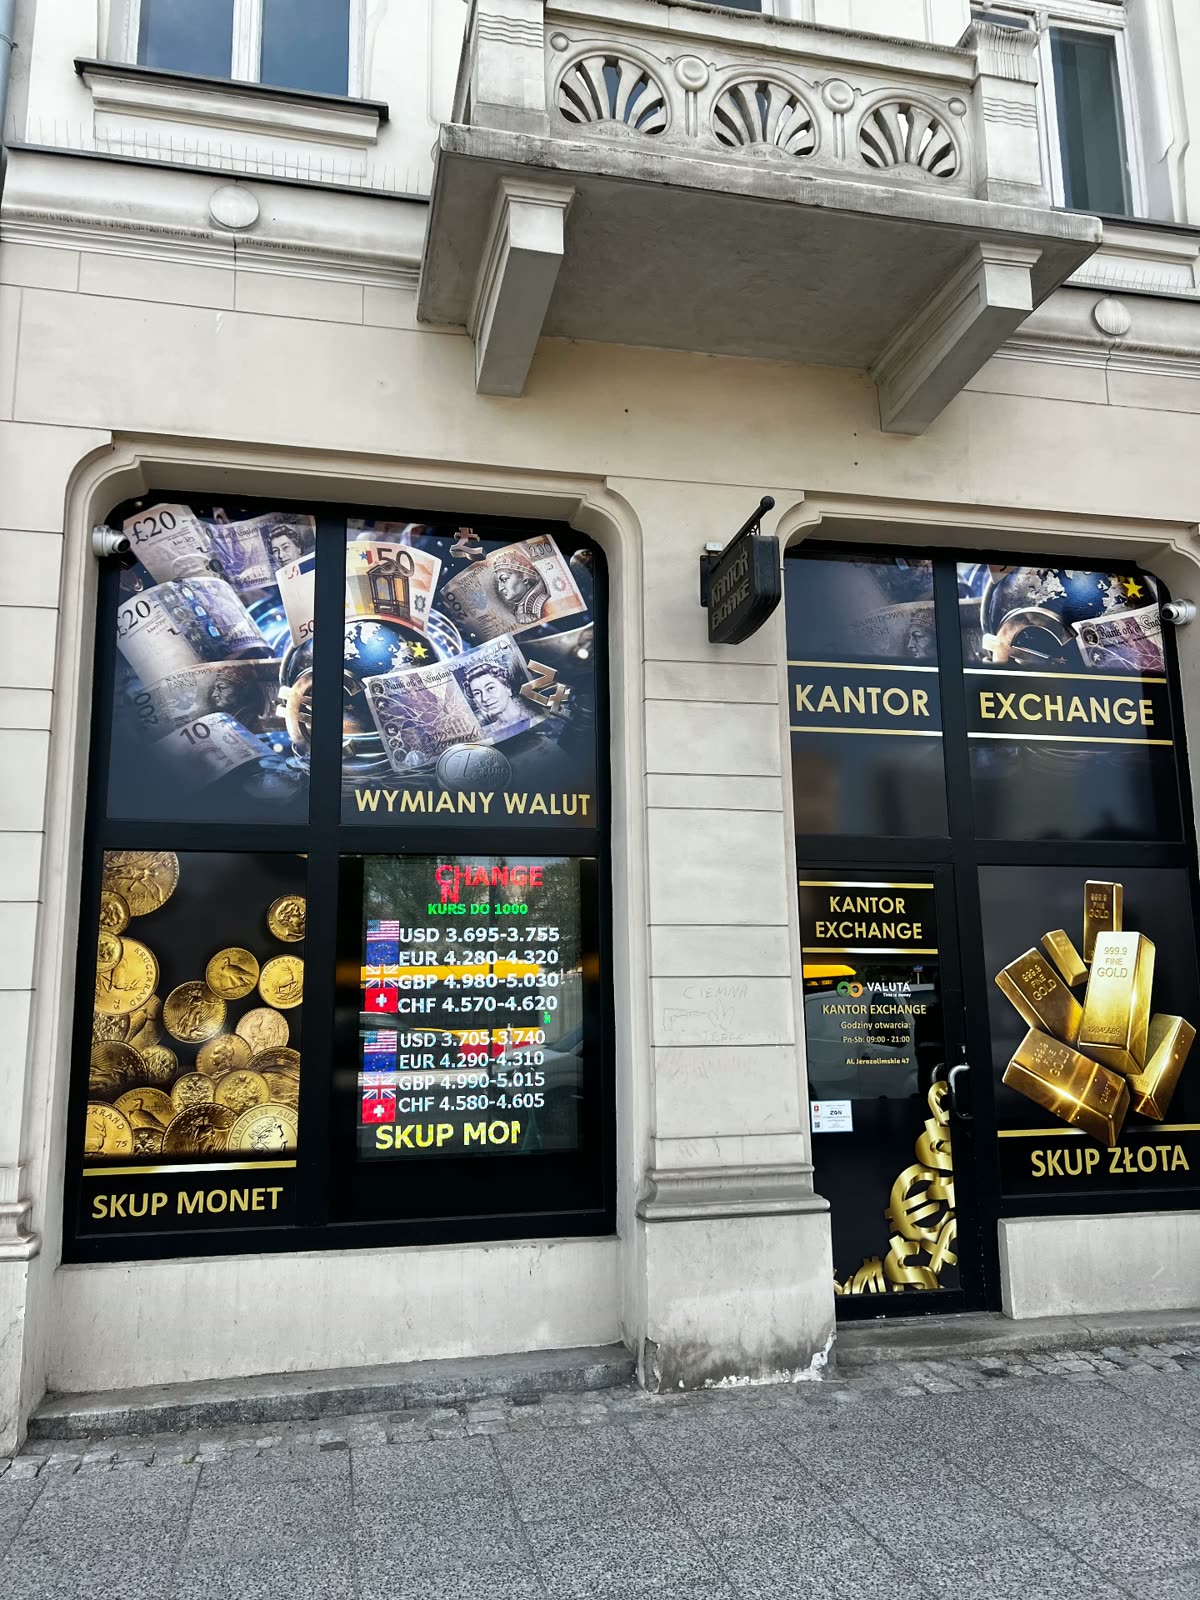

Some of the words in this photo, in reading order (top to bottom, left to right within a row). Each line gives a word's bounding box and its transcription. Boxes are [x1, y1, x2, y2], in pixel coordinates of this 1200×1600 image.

[377, 547, 415, 578] 50
[712, 551, 749, 607] KANTOR
[795, 684, 930, 717] KANTOR
[979, 691, 1154, 726] EXCHANGE
[180, 722, 211, 745] 10
[354, 789, 494, 814] WYMIANY
[504, 792, 591, 816] WALUT
[435, 864, 544, 886] CHANGE
[427, 903, 466, 915] KURS
[470, 903, 490, 915] DO
[494, 903, 529, 915] 1000
[829, 896, 906, 914] KANTOR
[400, 928, 440, 943] USD
[445, 927, 560, 943] 3.695-3.755
[815, 921, 923, 939] EXCHANGE
[399, 951, 439, 966] EUR
[443, 950, 559, 966] 4.280-4.320
[397, 975, 438, 990] GBP
[443, 973, 559, 989] 4.980-5.030
[1097, 967, 1128, 978] GOLD
[866, 981, 911, 992] VALUTA
[1032, 979, 1057, 1001] GOLD
[397, 998, 437, 1014] CHF
[441, 995, 558, 1013] 4.570-4.620
[822, 1004, 867, 1015] KANTOR
[870, 1004, 927, 1015] EXCHANGE
[841, 1021, 873, 1030] Godziny
[874, 1021, 911, 1029] otwarcia:
[400, 1032, 437, 1048] USD
[440, 1030, 546, 1047] 3.705-3.740
[891, 1035, 910, 1043] 21:00
[399, 1053, 435, 1070] EUR
[439, 1051, 544, 1069] 4.290-4.310
[398, 1075, 435, 1091] GBP
[440, 1072, 545, 1090] 4.990-5.015
[398, 1096, 435, 1113] CHF
[438, 1093, 545, 1111] 4.580-4.605
[115, 1140, 128, 1148] 75
[375, 1123, 455, 1150] SKUP
[1031, 1148, 1100, 1177] SKUP
[1107, 1144, 1190, 1173] ZŁOTA
[92, 1192, 168, 1219] SKUP
[177, 1187, 284, 1215] MONET
